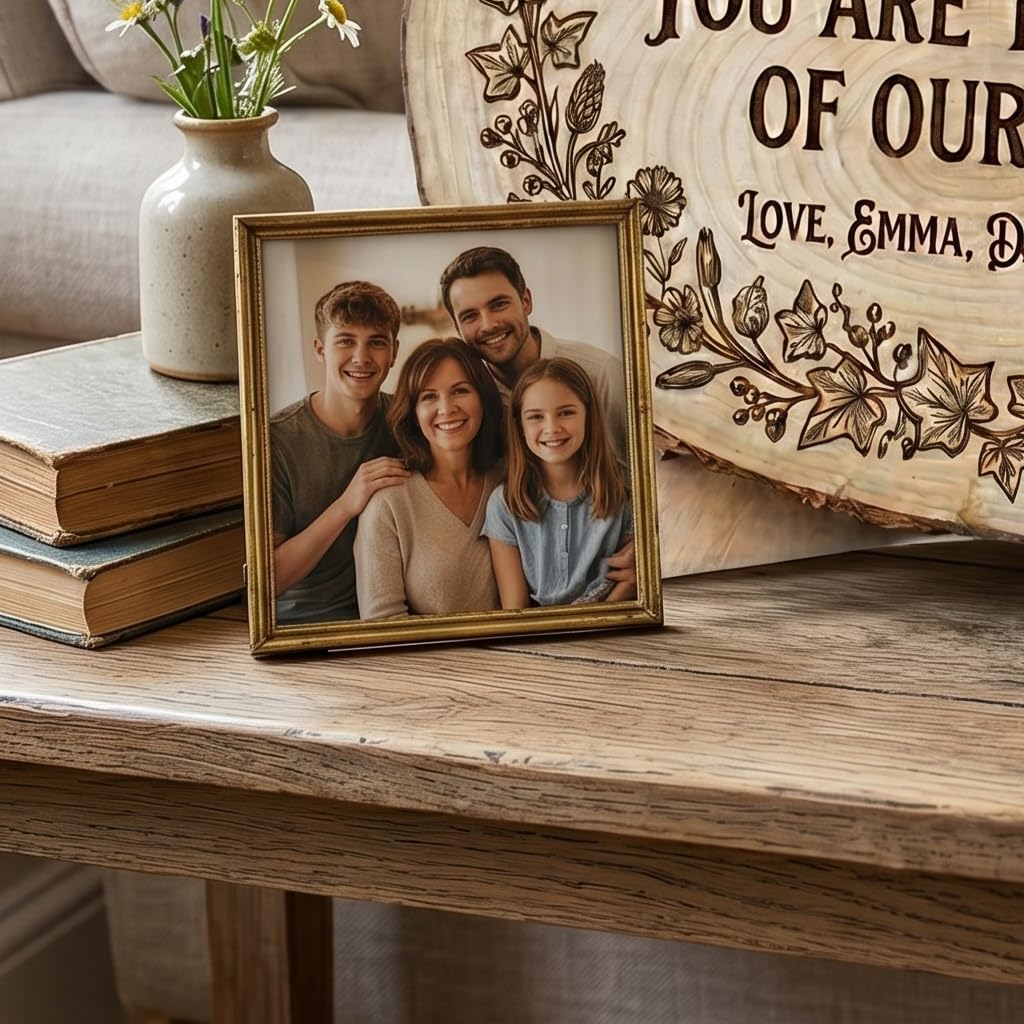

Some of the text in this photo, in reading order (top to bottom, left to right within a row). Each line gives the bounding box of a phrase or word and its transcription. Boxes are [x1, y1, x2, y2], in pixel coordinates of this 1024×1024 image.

[749, 65, 846, 151] OF
[737, 189, 835, 250] LOVE,
[840, 199, 975, 264] EMMA,
